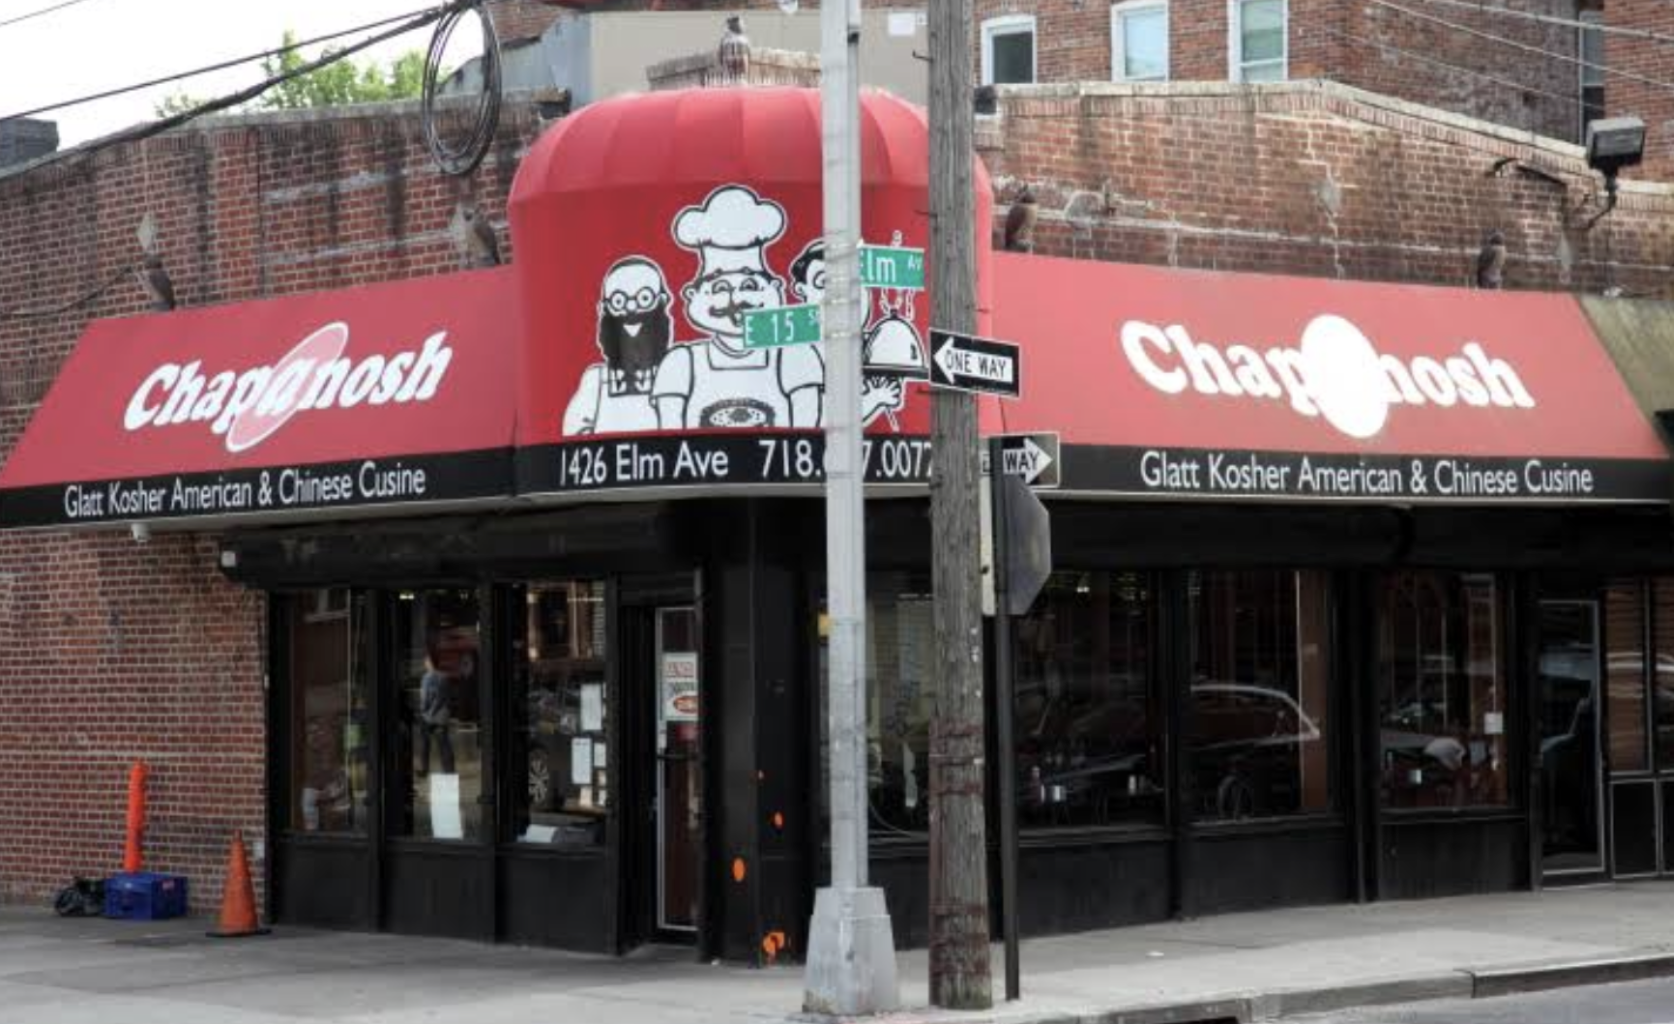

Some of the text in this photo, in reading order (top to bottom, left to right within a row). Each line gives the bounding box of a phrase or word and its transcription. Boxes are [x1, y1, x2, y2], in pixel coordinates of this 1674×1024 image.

[859, 251, 896, 283] lm
[745, 315, 754, 345] E
[770, 311, 794, 344] 15
[123, 330, 453, 435] Chapanosh
[944, 348, 1007, 378] ONE WAY
[1120, 319, 1537, 417] Chapnosh
[560, 446, 607, 486] 1426
[616, 442, 664, 481] Elm
[672, 440, 729, 478] Ave
[1004, 451, 1040, 471] WAY
[1140, 450, 1594, 494] Glatt Kosher American & Chinese Cusine
[64, 460, 426, 518] Glatt Kosher American & Chinese Cusine
